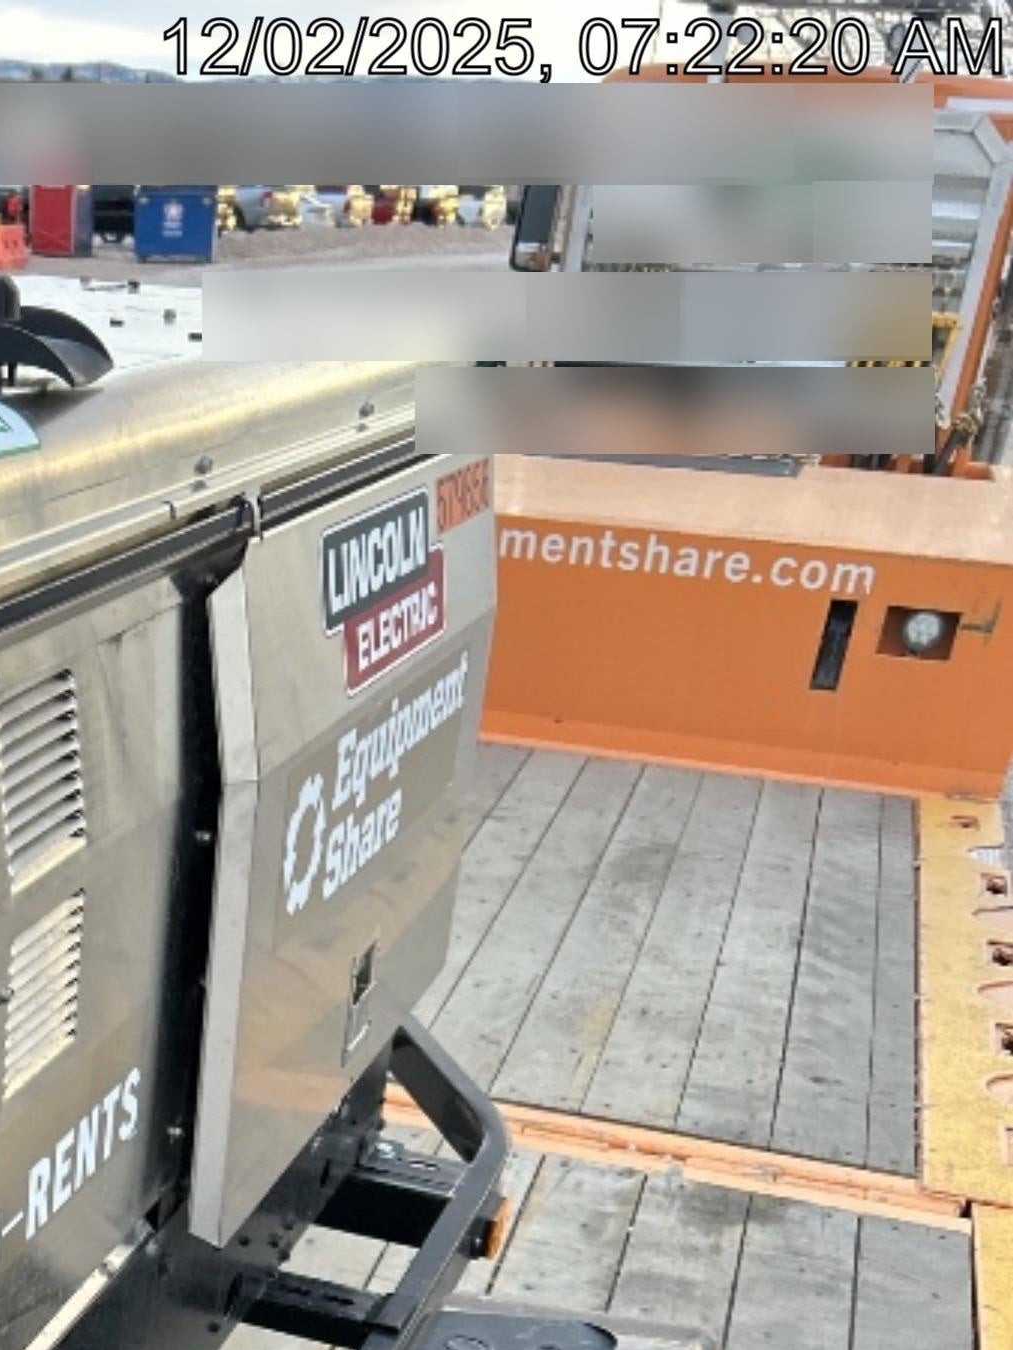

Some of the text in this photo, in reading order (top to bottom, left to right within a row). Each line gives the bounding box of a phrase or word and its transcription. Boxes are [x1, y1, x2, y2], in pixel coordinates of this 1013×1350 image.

[327, 505, 427, 616] LINCOLN
[498, 527, 876, 595] mentshare.com
[356, 581, 438, 673] ELECTRIC
[332, 650, 469, 812] Equipment
[322, 788, 402, 901] Share
